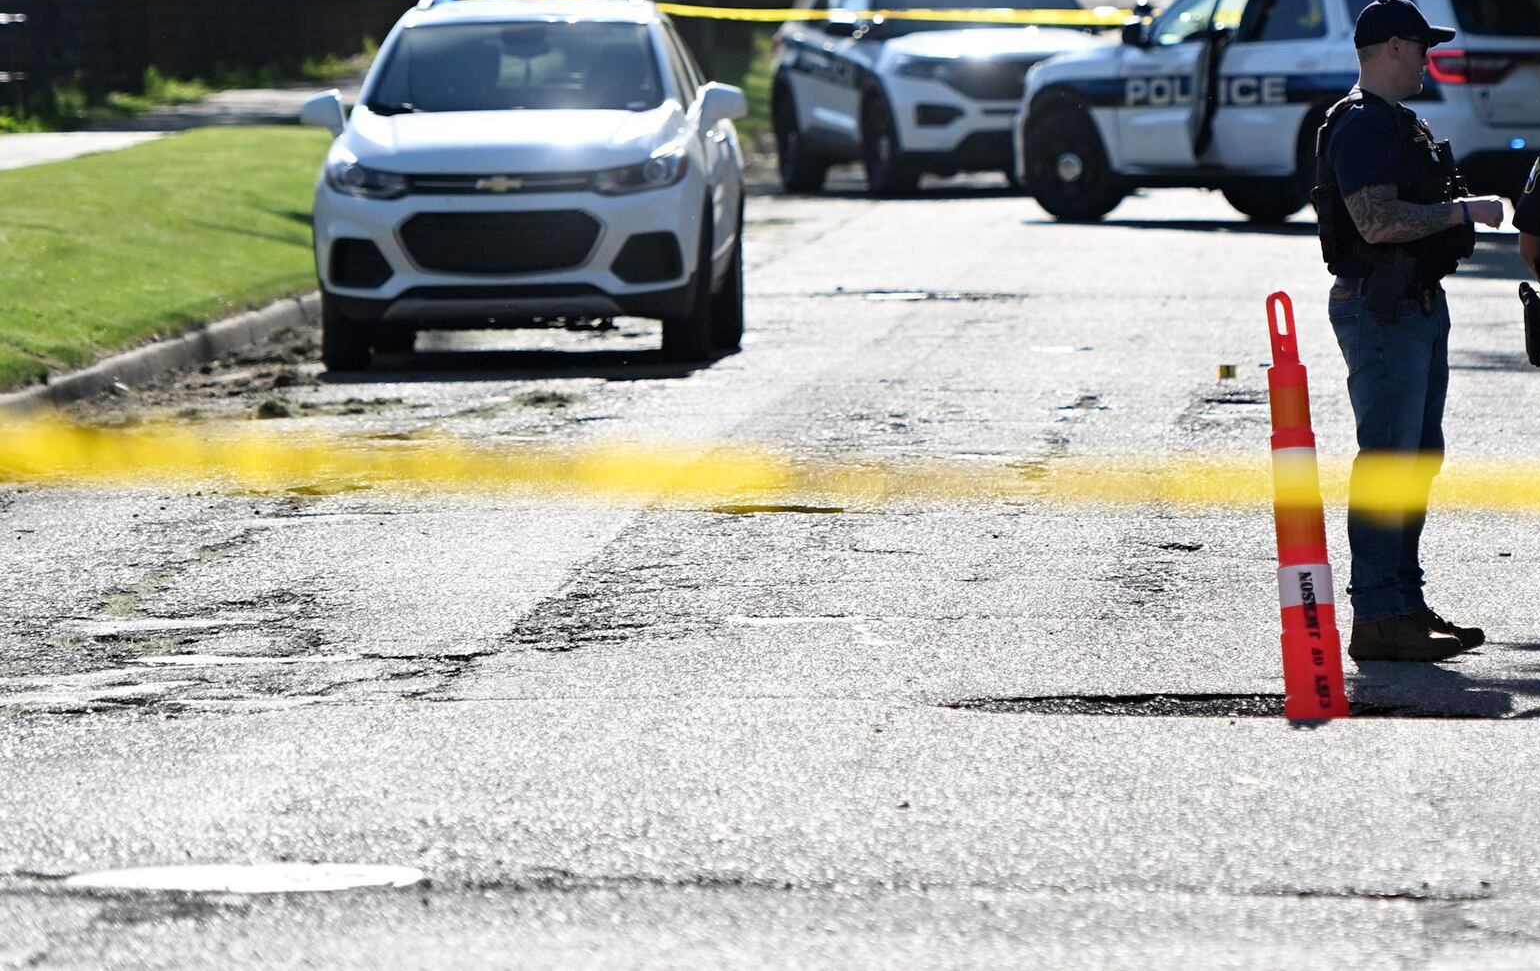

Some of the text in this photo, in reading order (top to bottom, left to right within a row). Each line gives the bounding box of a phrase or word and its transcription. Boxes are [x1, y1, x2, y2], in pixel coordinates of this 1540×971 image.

[1125, 77, 1288, 106] POLICE
[1299, 572, 1331, 708] CITY OF JACKSON
